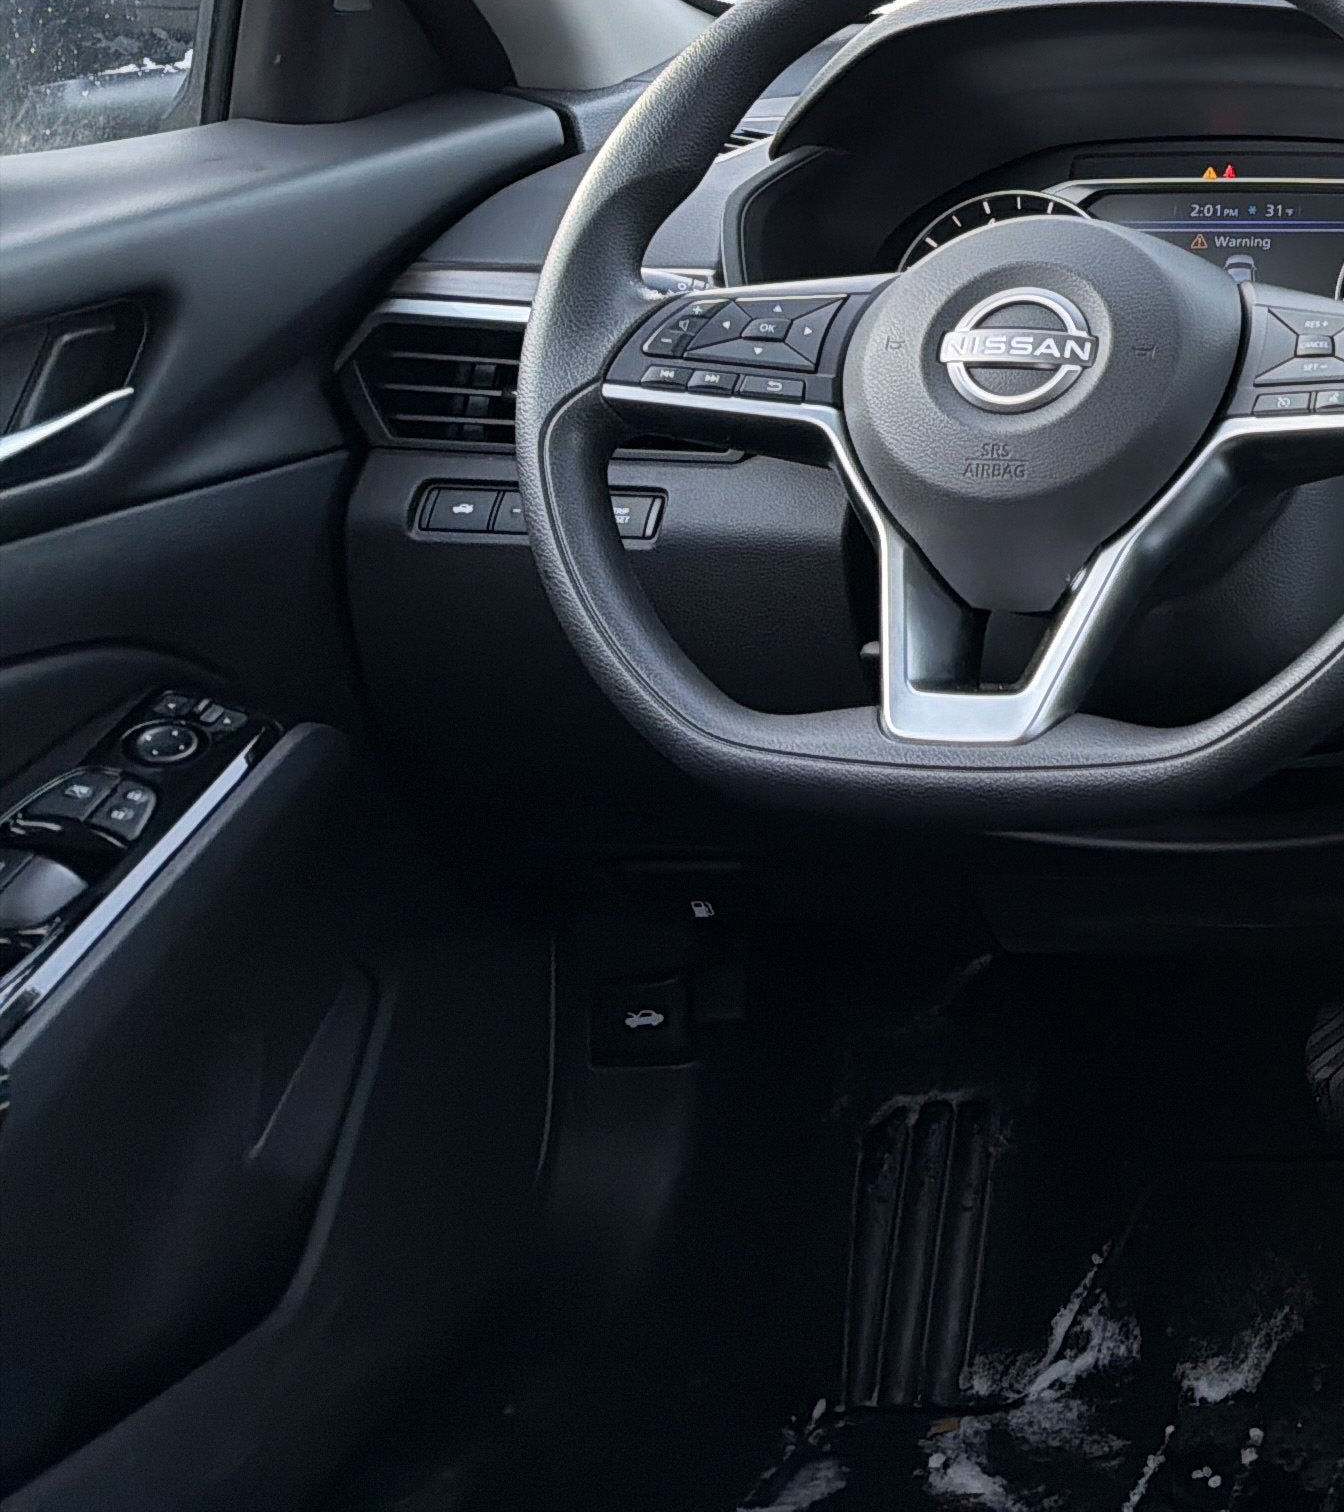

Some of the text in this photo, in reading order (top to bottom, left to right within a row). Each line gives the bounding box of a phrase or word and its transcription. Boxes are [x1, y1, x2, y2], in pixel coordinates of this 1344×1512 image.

[1214, 235, 1272, 251] Warning
[759, 323, 776, 334] OK
[946, 335, 1092, 361] NISSAN
[1300, 341, 1329, 349] CANCEL
[981, 442, 1010, 458] SRS
[962, 463, 1026, 478] AIRBAG
